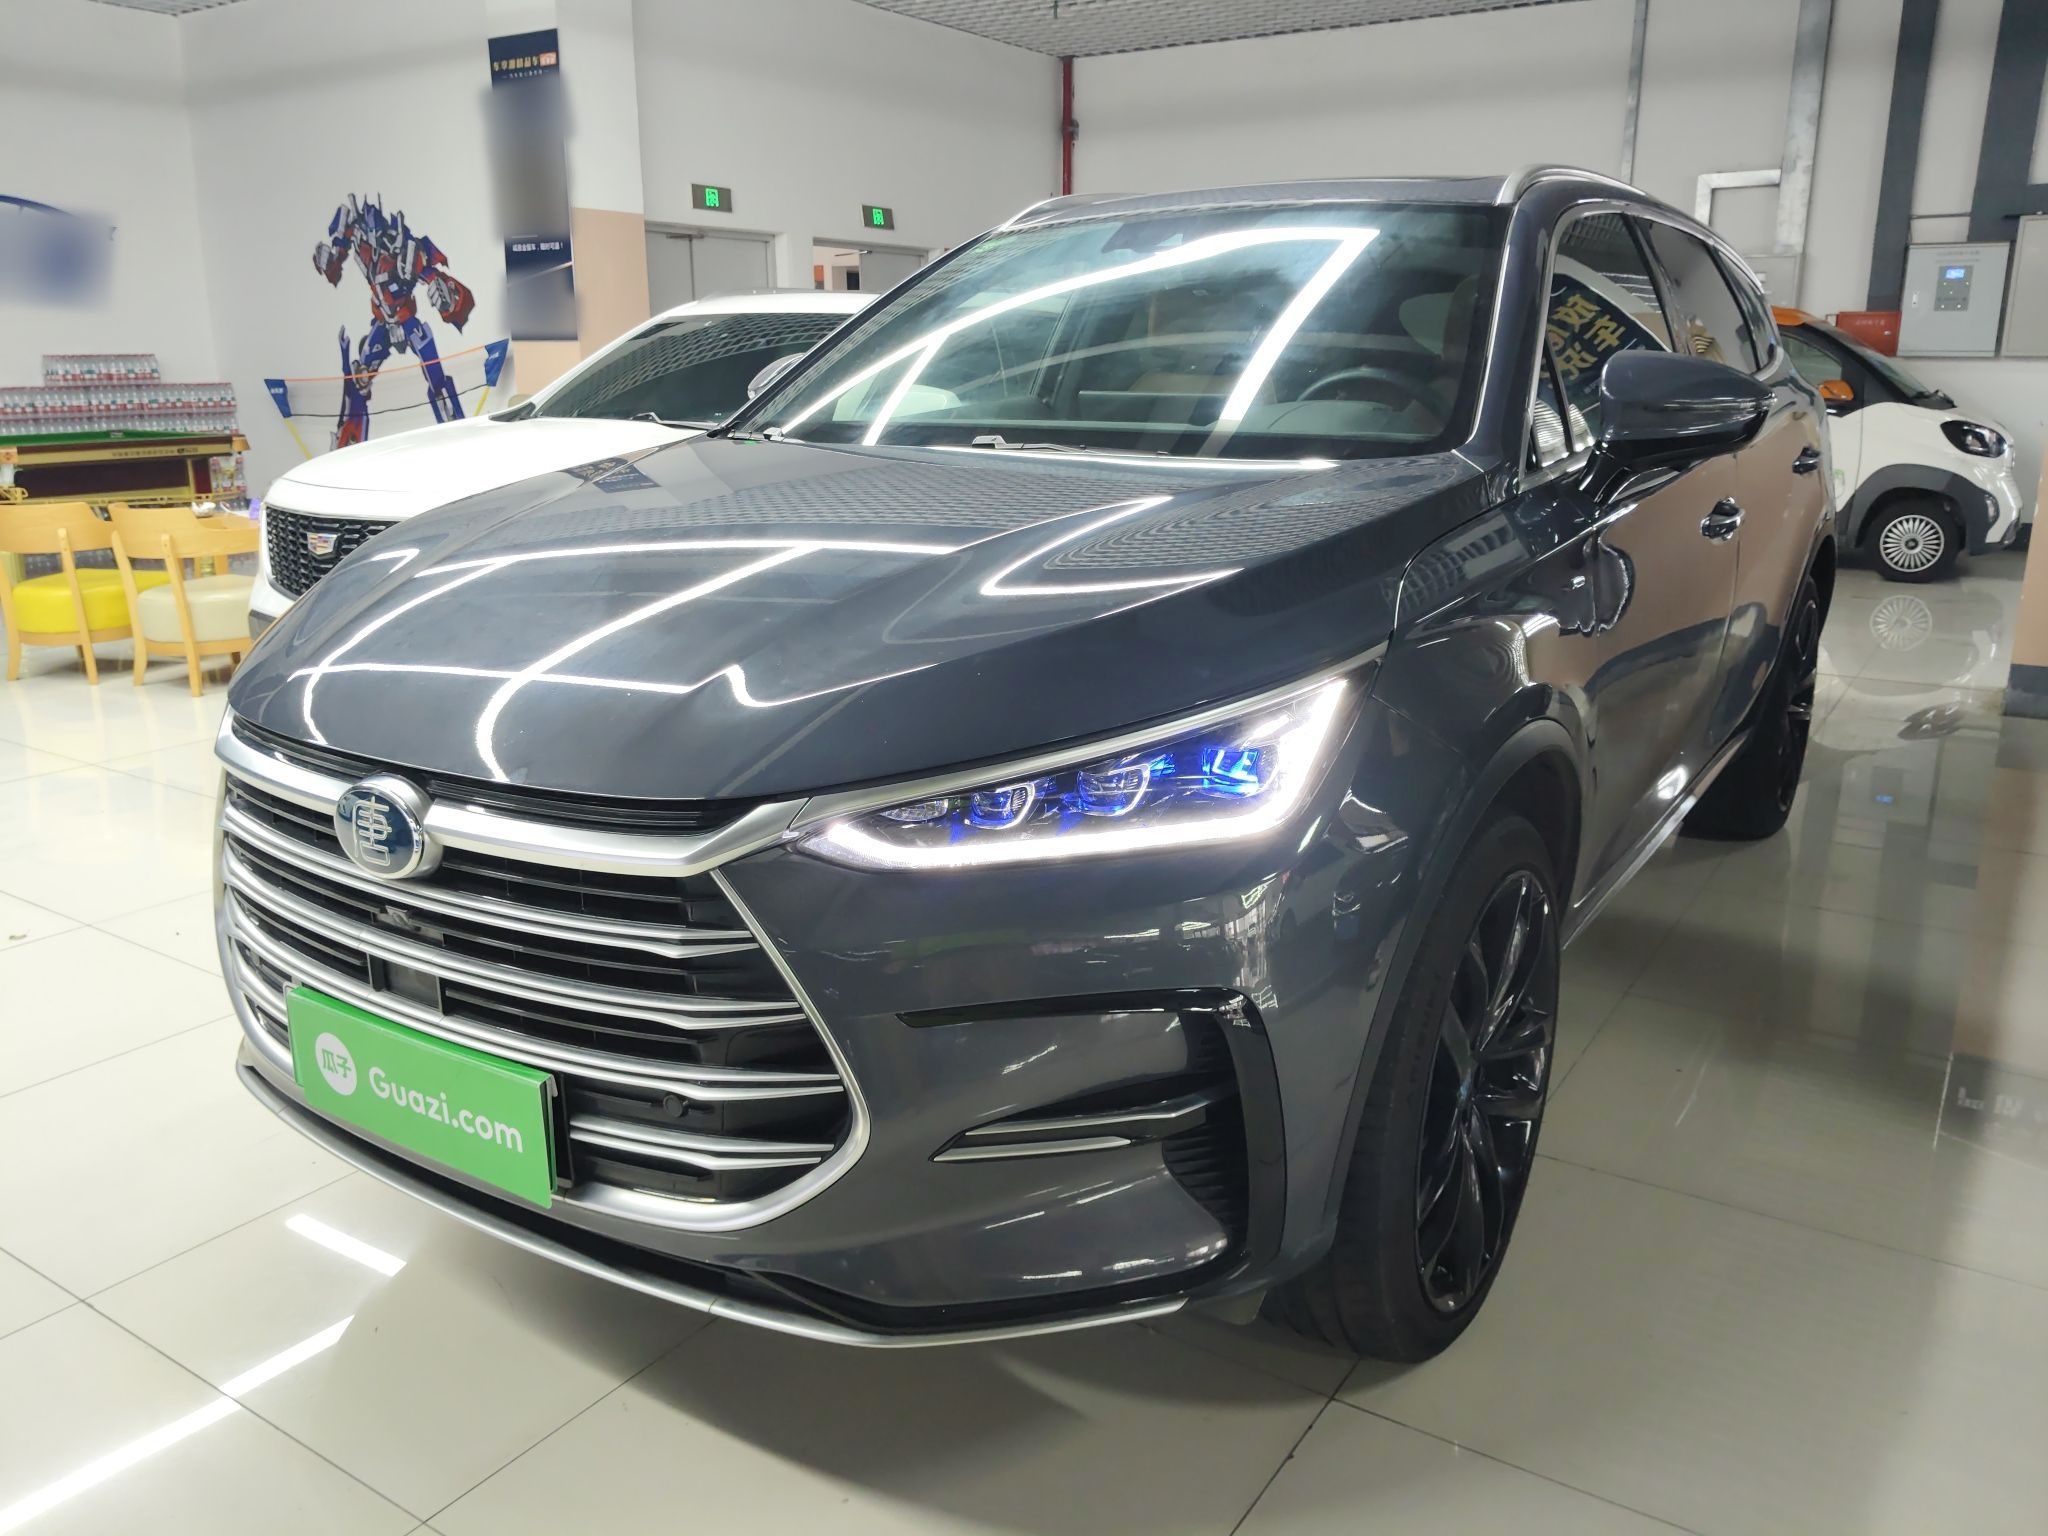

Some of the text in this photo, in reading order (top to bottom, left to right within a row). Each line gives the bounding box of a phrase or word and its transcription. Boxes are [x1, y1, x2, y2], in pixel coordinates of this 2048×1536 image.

[352, 795, 393, 867] 唐
[321, 1048, 353, 1078] 瓜子
[368, 1066, 524, 1153] Guazi.com
